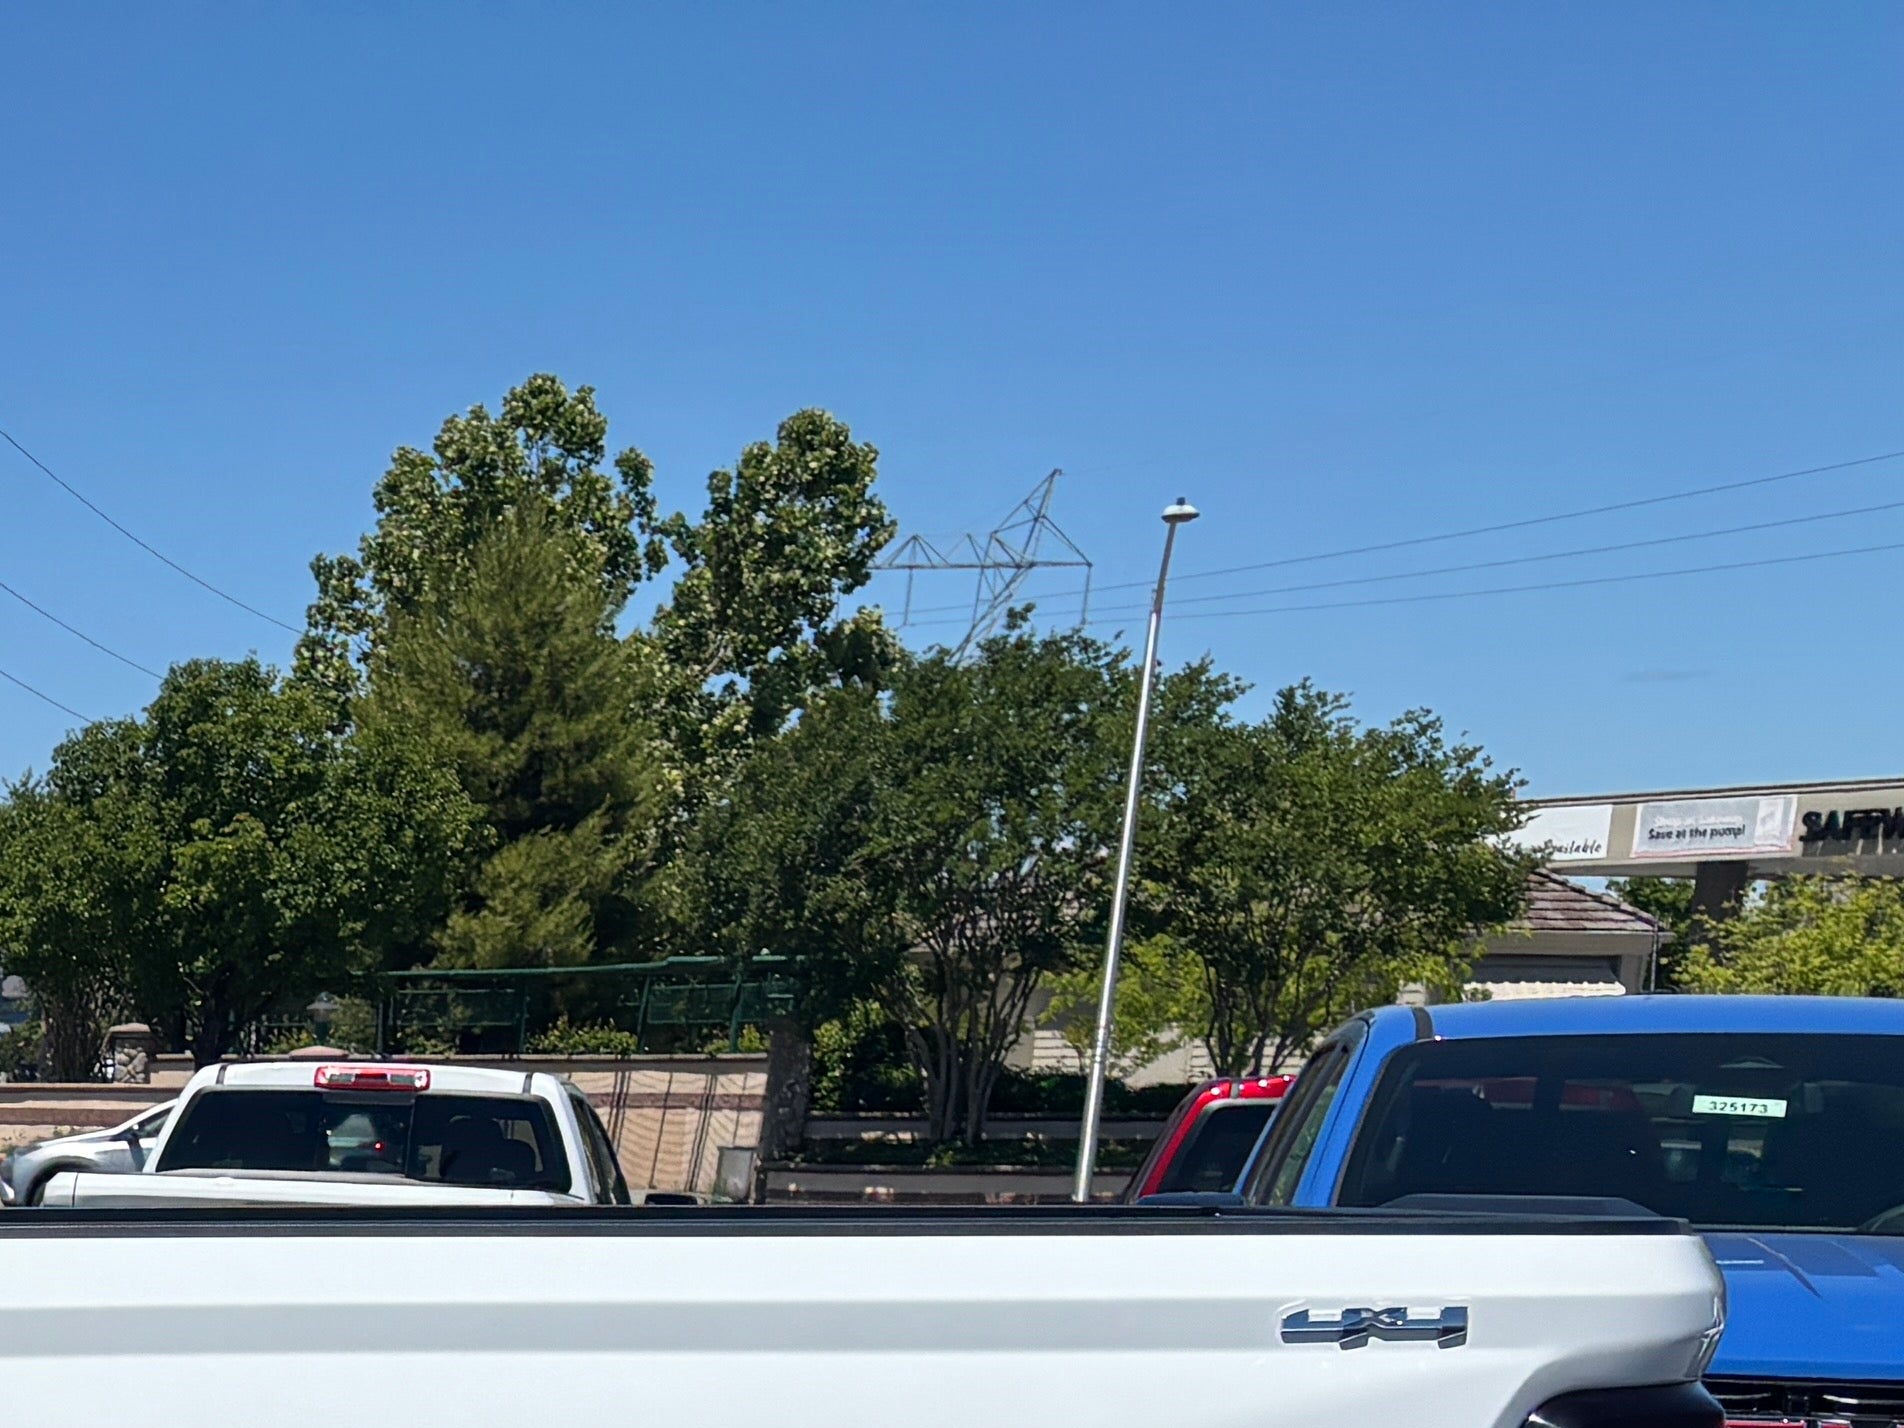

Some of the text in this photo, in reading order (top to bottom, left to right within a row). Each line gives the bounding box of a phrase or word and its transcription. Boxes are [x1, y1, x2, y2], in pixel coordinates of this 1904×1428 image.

[1648, 828, 1673, 839] Save
[1689, 828, 1707, 838] the
[1709, 1101, 1768, 1114] 325173
